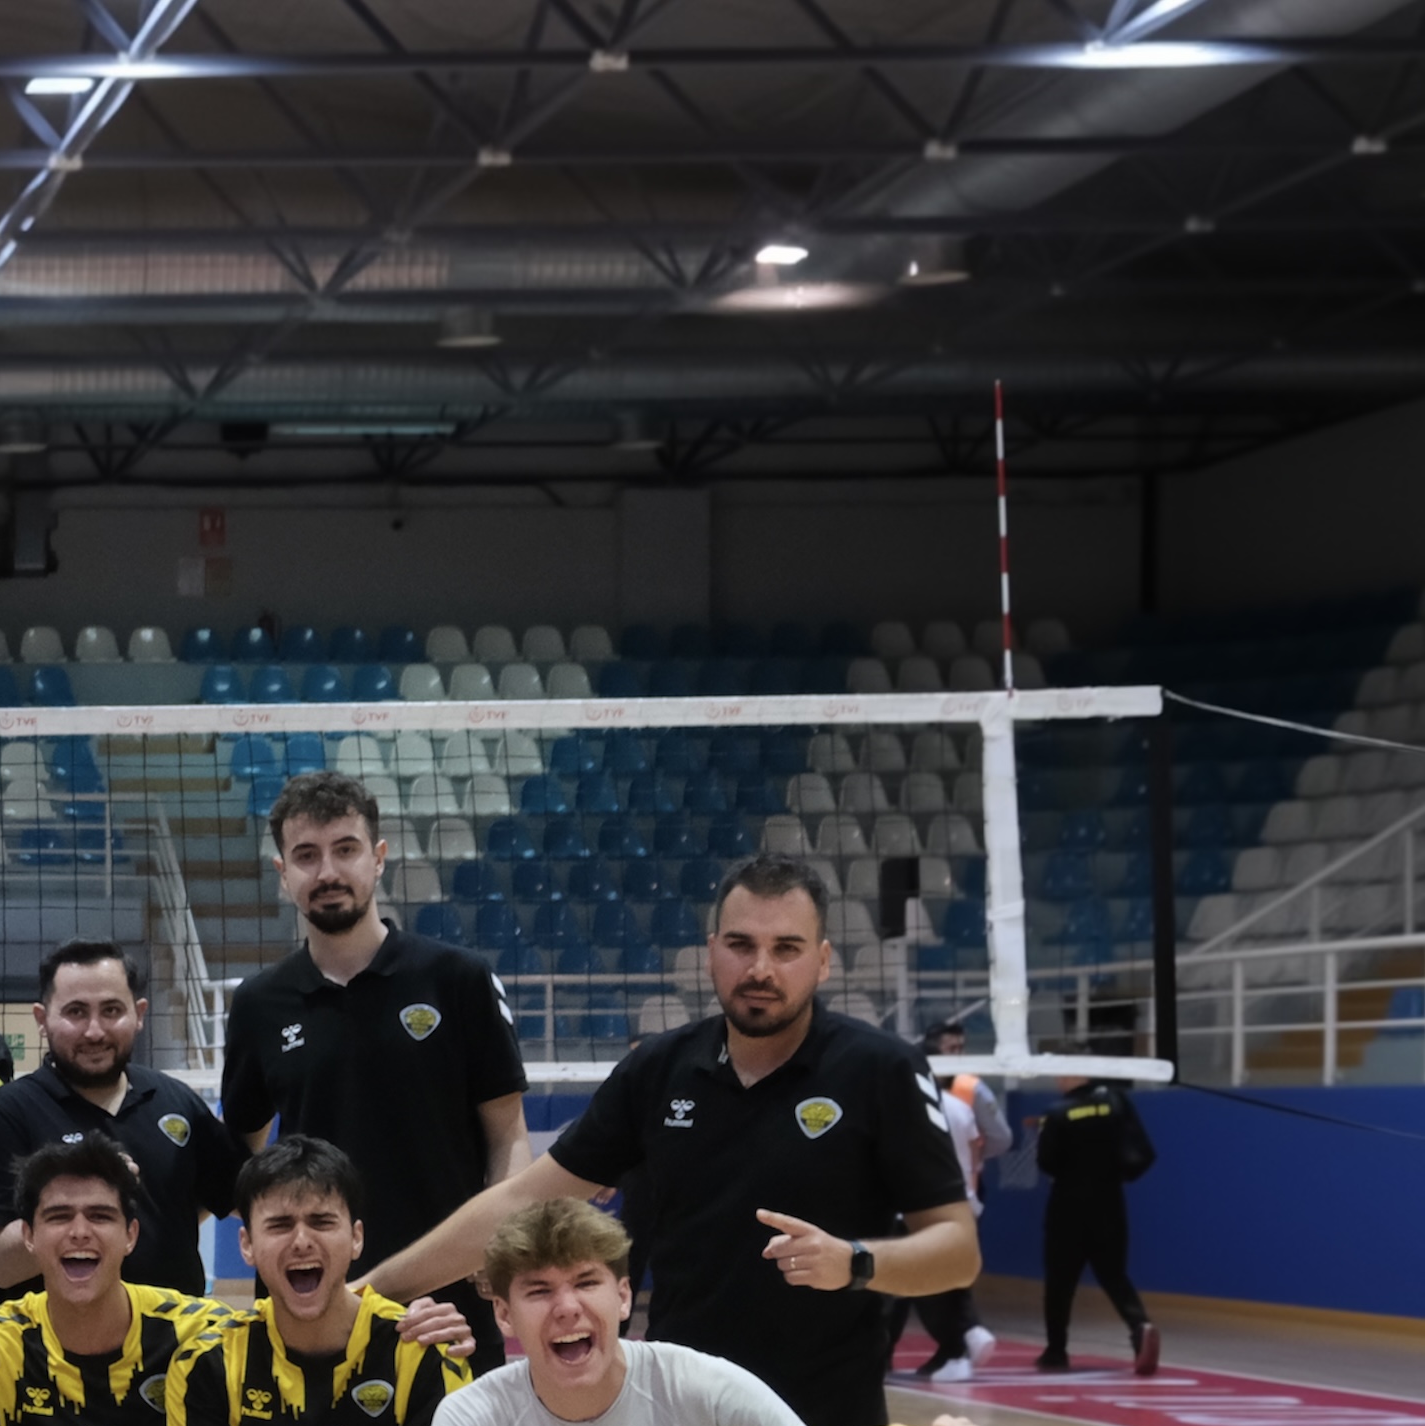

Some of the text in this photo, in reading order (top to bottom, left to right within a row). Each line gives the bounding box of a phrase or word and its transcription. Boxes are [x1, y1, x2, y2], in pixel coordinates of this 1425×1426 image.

[16, 717, 37, 727] TVF
[251, 713, 271, 724] TVF
[369, 711, 390, 722] TVF
